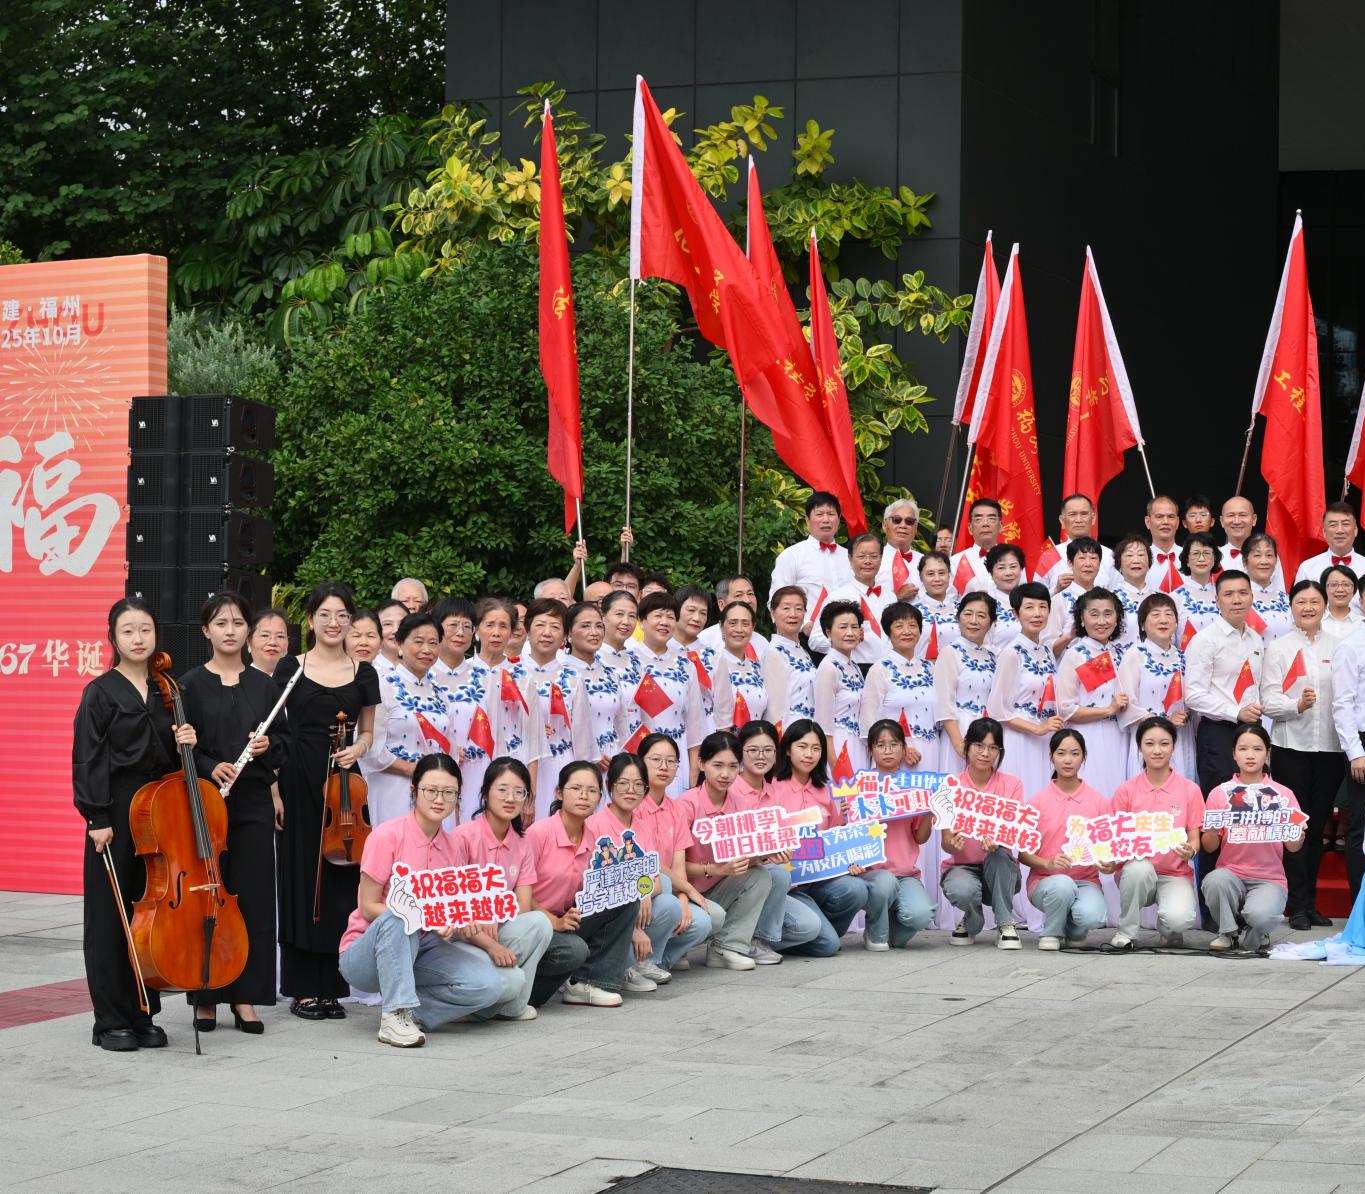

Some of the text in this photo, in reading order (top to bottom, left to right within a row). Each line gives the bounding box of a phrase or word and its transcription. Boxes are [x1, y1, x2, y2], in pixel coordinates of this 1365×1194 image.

[1018, 449, 1042, 497] UNIVERSITY
[0, 431, 121, 577] 福
[0, 639, 105, 677] 67华诞
[695, 808, 778, 842] 今朝桃李
[953, 786, 1040, 830] 祝福福大
[1205, 809, 1292, 829] 勇于拼搏的
[714, 827, 800, 860] 明日栋梁
[952, 812, 1042, 855] 越来越好
[1228, 823, 1301, 844] 奉献精神
[585, 853, 658, 894] 严谨求实的
[798, 844, 881, 878] 为校庆喝彩
[410, 865, 505, 901] 祝福福大
[578, 880, 638, 915] 治学精神
[422, 893, 517, 929] 越来越好
